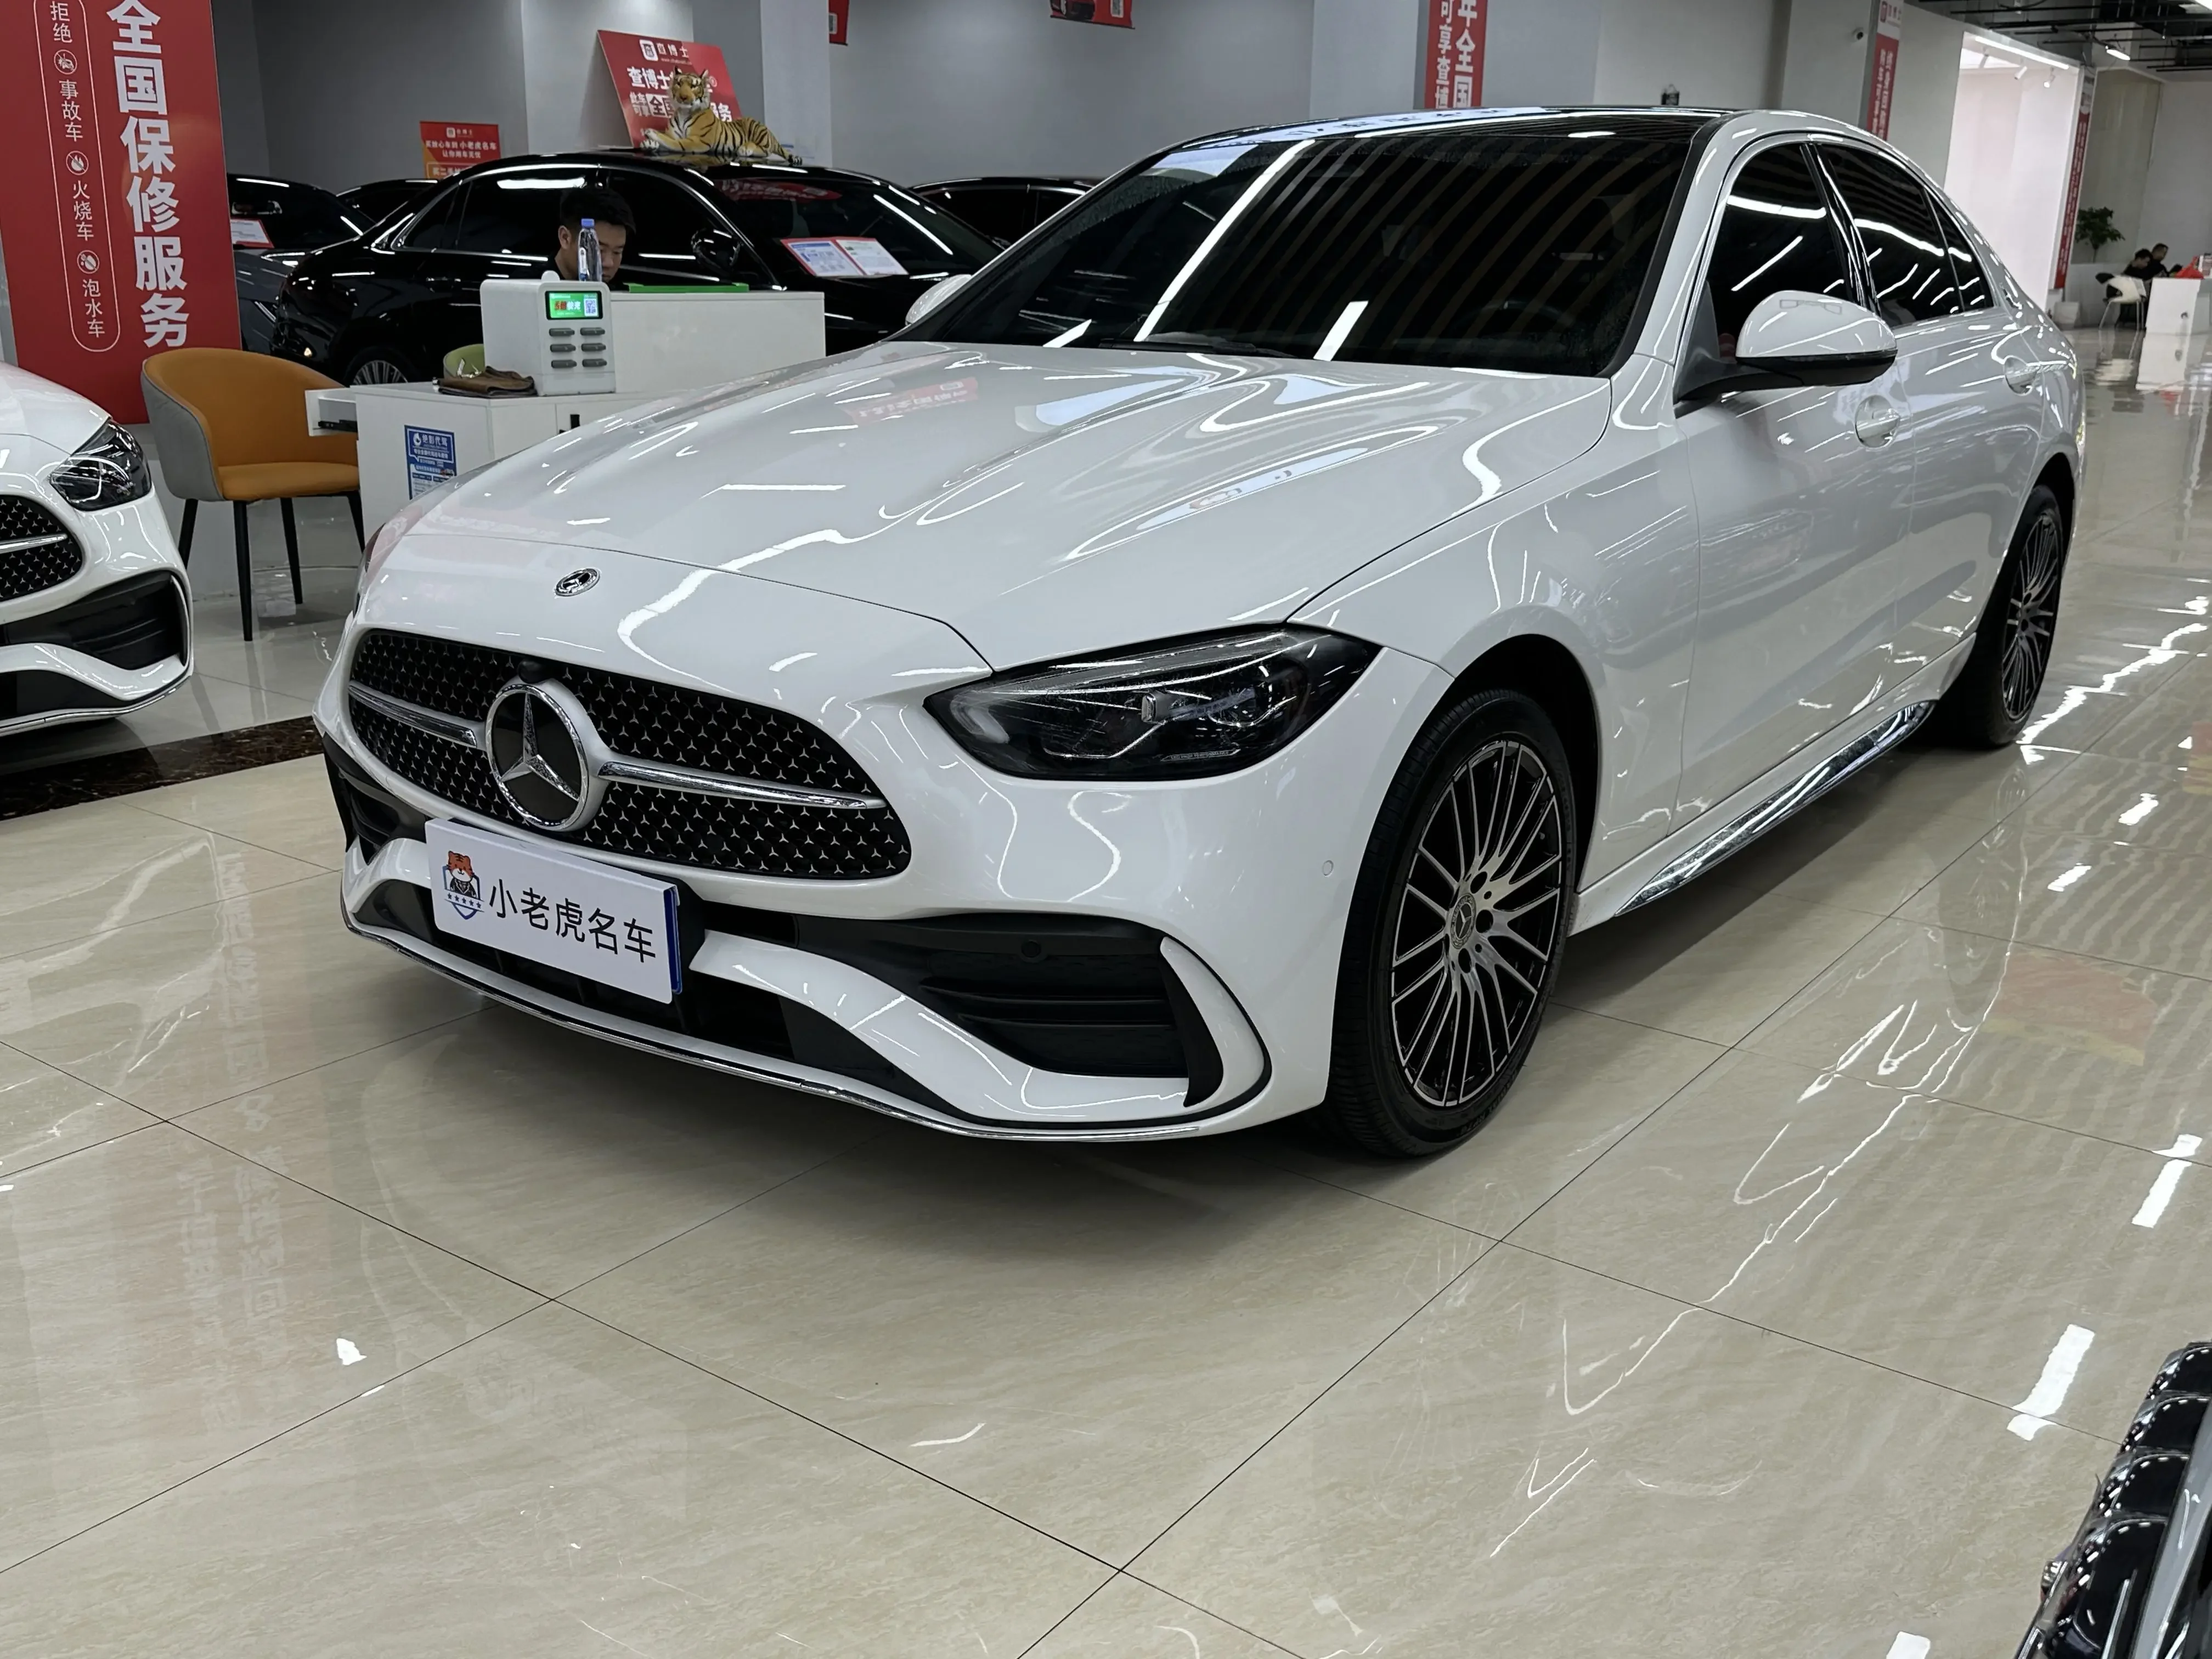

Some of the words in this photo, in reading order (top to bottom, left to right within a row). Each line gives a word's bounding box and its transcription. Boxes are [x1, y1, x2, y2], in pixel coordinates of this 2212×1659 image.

[49, 1, 72, 43] 拒绝
[656, 42, 690, 59] 查博士
[59, 80, 83, 142] 事故车
[107, 0, 190, 349] 全国保修服务
[72, 180, 94, 241] 火烧车
[82, 279, 105, 338] 泡水车
[489, 879, 656, 963] 小老虎名车
